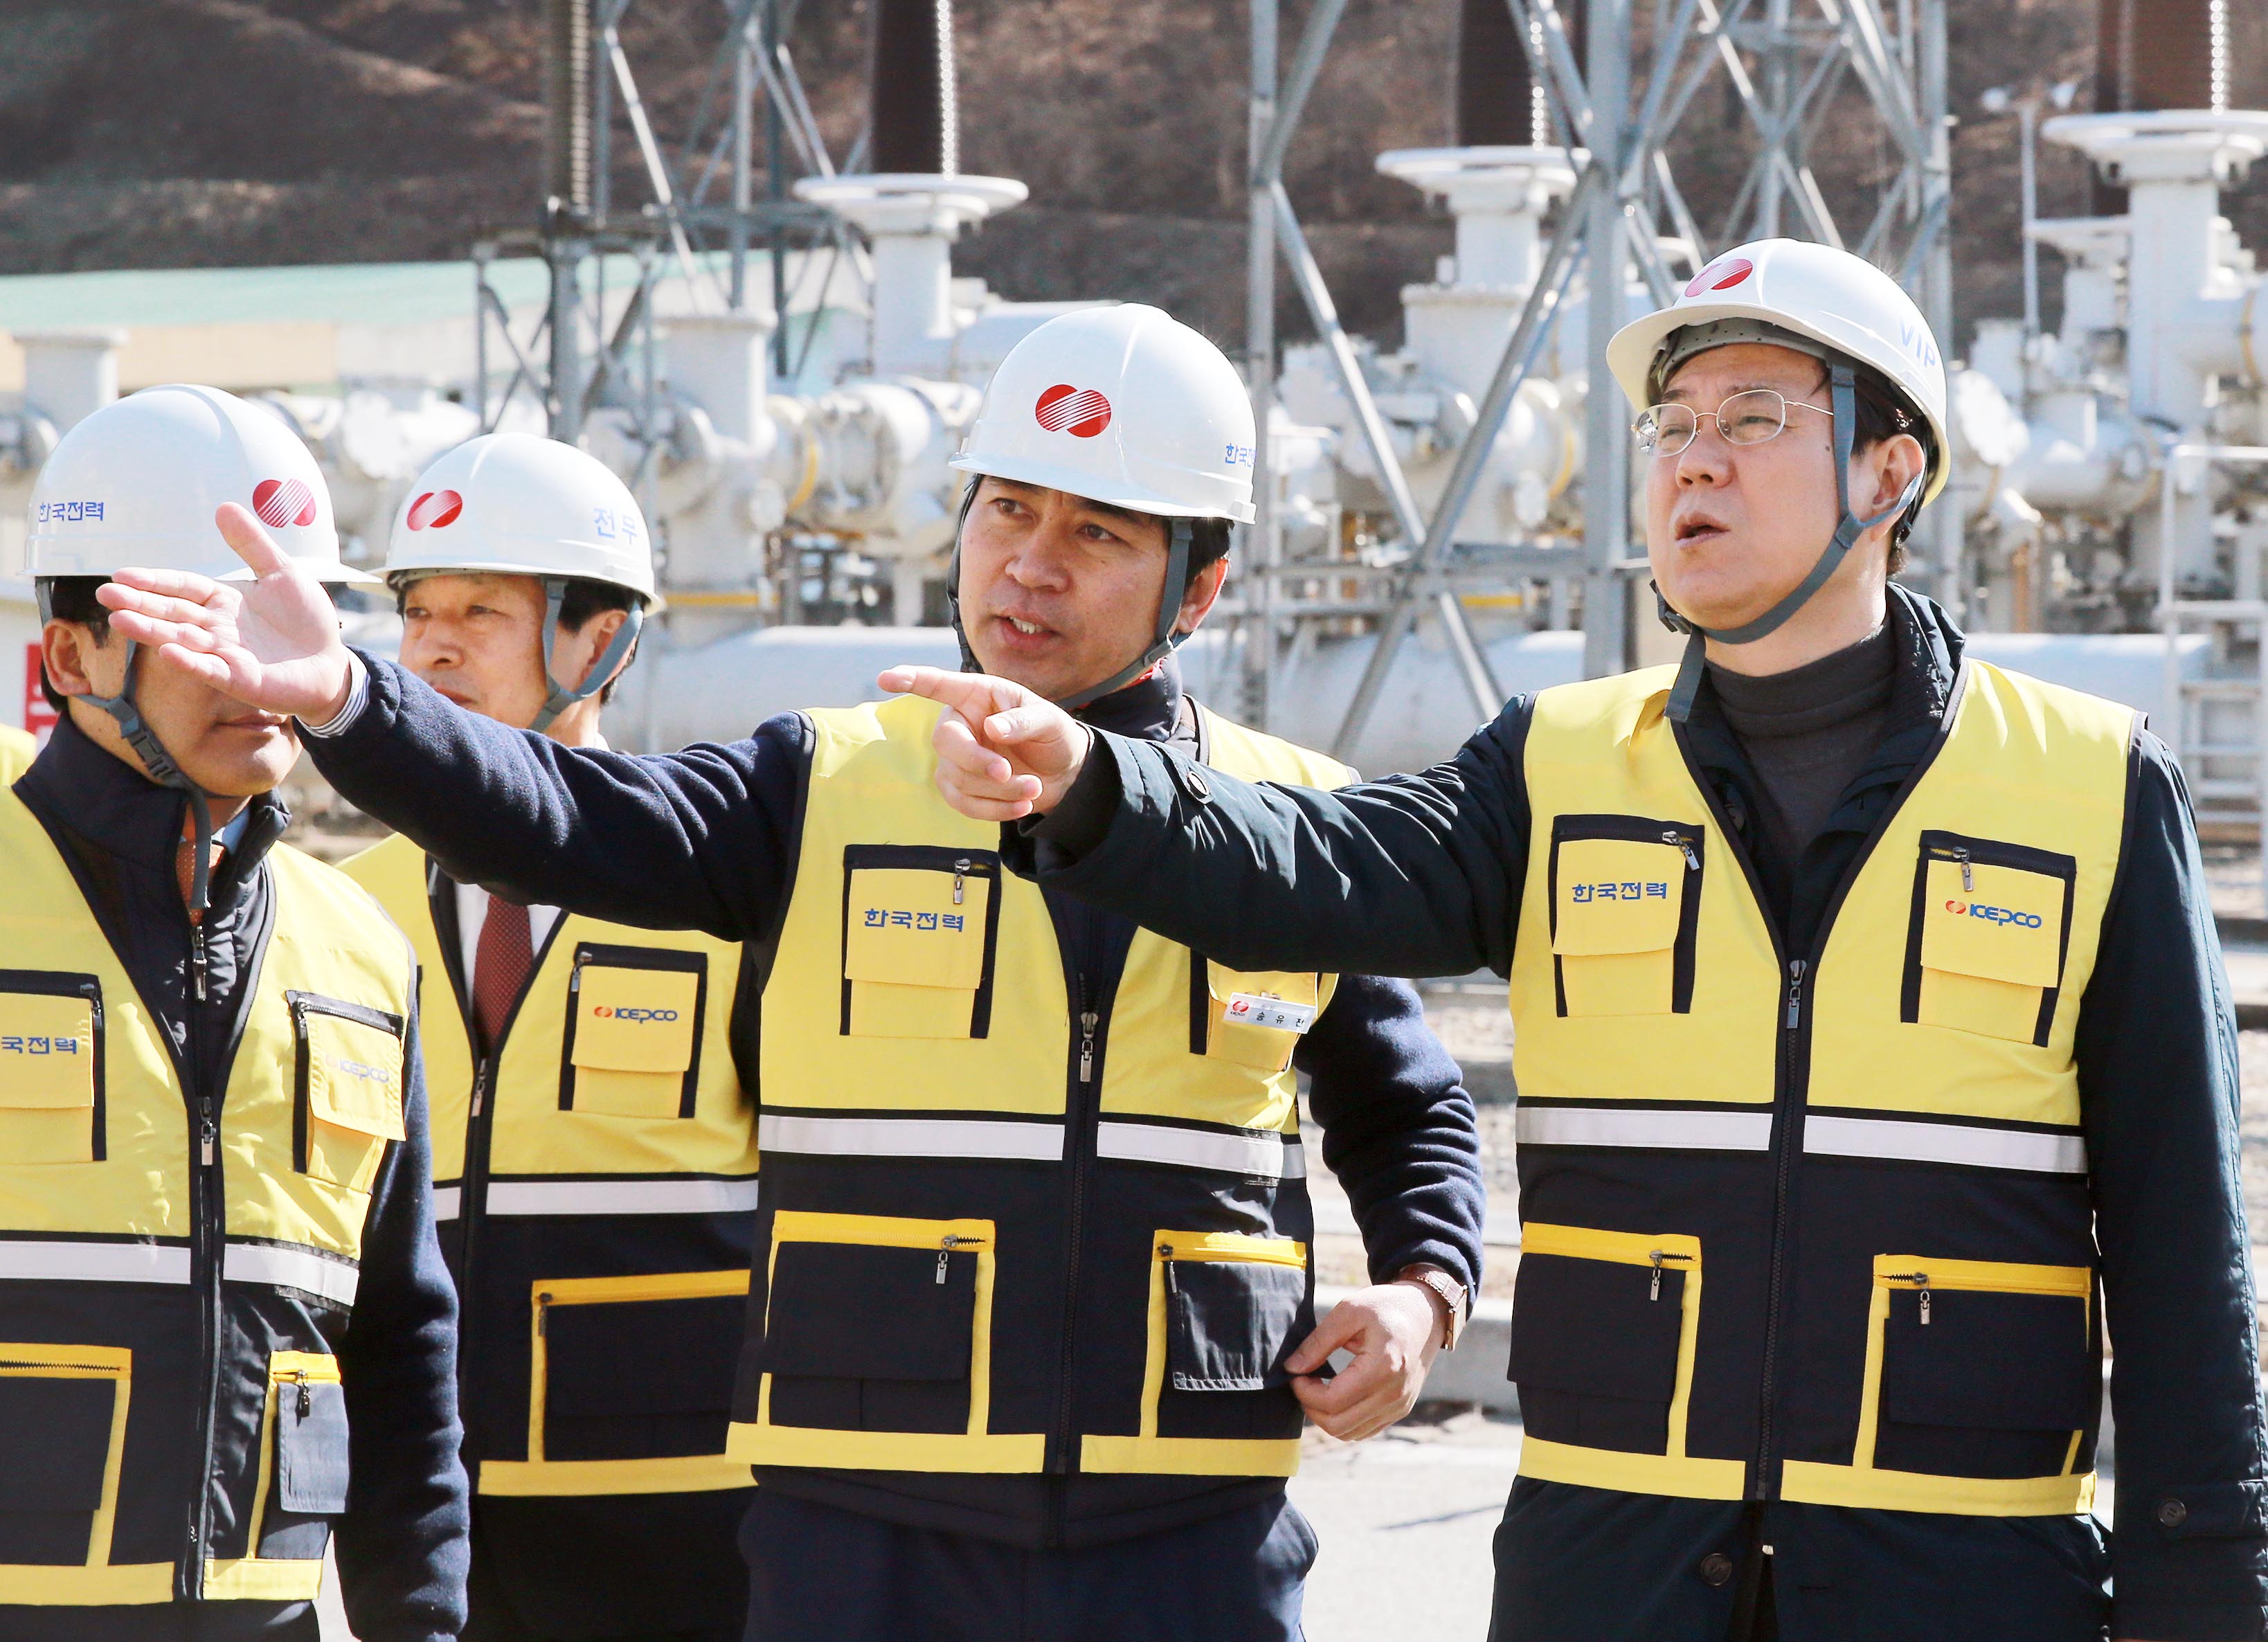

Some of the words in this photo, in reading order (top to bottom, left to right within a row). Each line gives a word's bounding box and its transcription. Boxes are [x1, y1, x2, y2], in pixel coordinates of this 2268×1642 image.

[1899, 319, 1936, 367] VIP
[1225, 443, 1257, 467] 한국전
[39, 502, 104, 522] 한국전력
[593, 507, 637, 545] 전무
[1572, 882, 1667, 903] 한국전력
[864, 908, 964, 932] 한국전력
[1970, 904, 2042, 928] KEPCO
[615, 1008, 678, 1024] KEPCO
